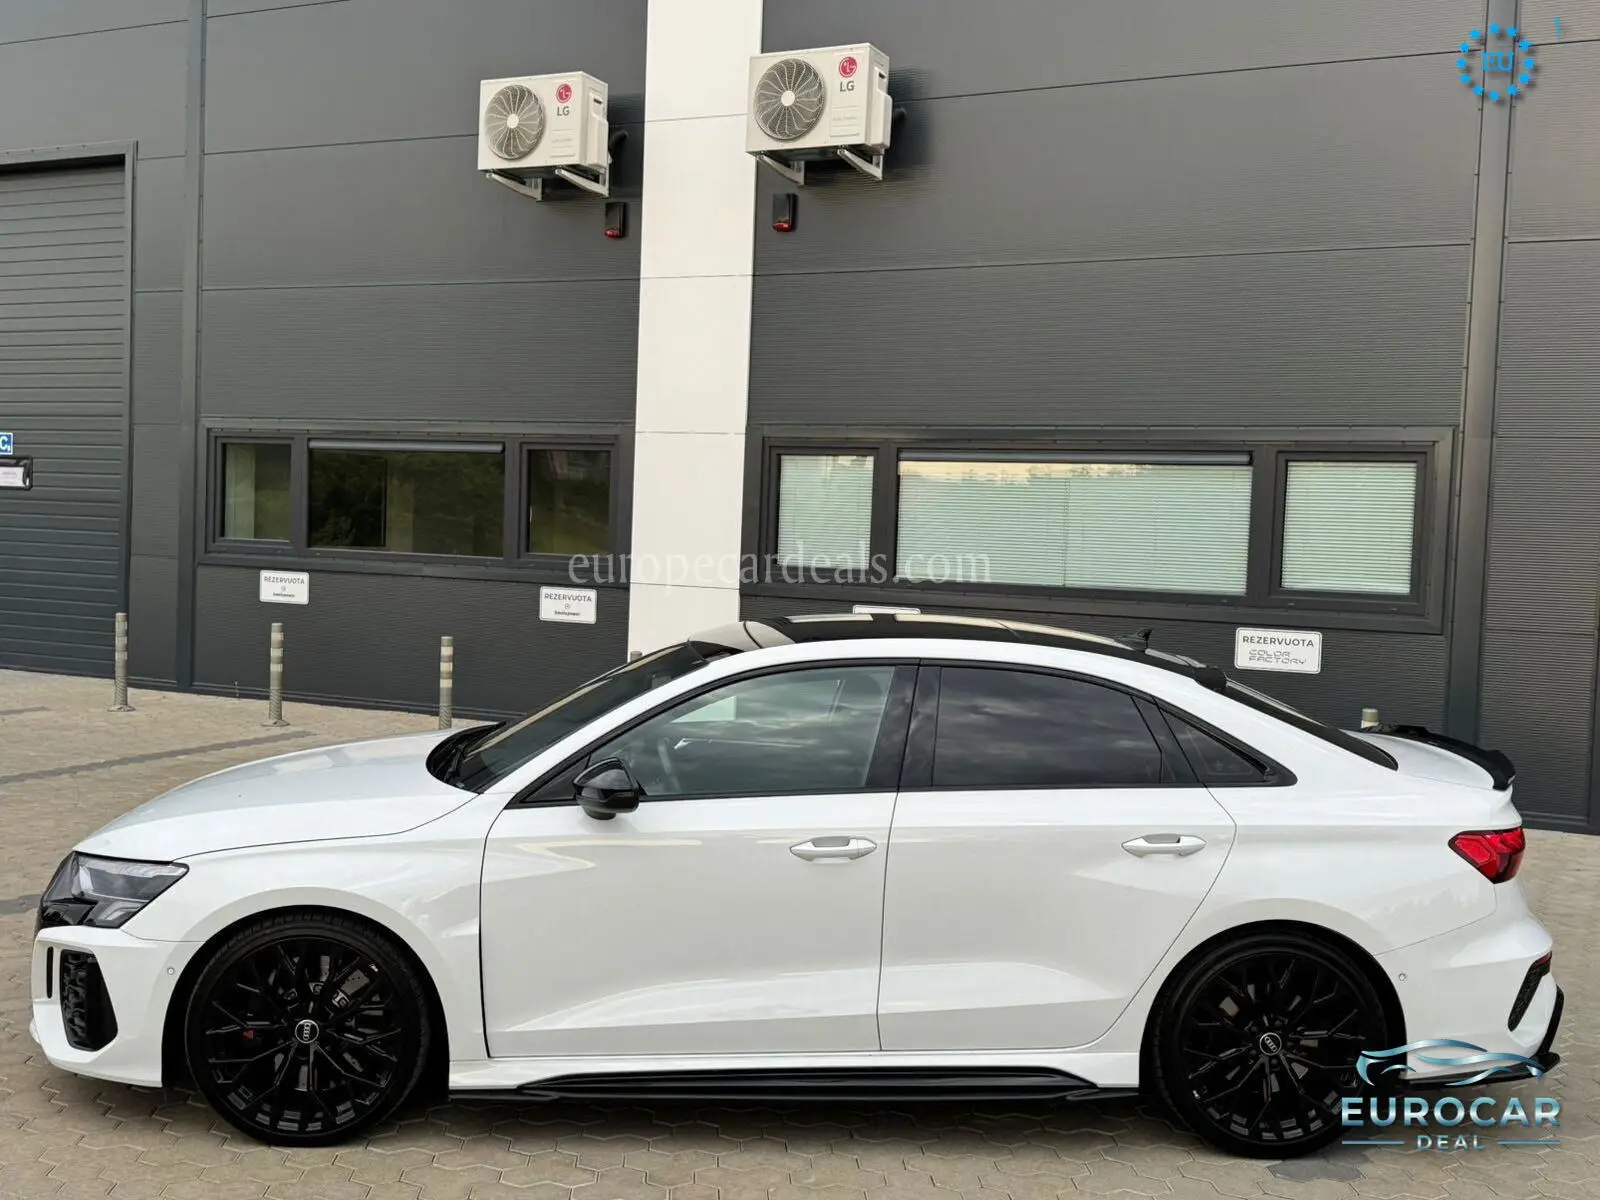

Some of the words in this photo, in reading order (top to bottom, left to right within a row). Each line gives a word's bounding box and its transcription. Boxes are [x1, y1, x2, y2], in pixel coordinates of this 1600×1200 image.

[840, 80, 855, 92] LG
[556, 105, 570, 116] LG
[263, 575, 305, 584] REZERVUOTA
[544, 592, 592, 602] REZERVUOTA
[1242, 635, 1314, 648] REZERVUOTA
[1248, 649, 1290, 657] COLOR
[1248, 656, 1307, 665] FACTORY
